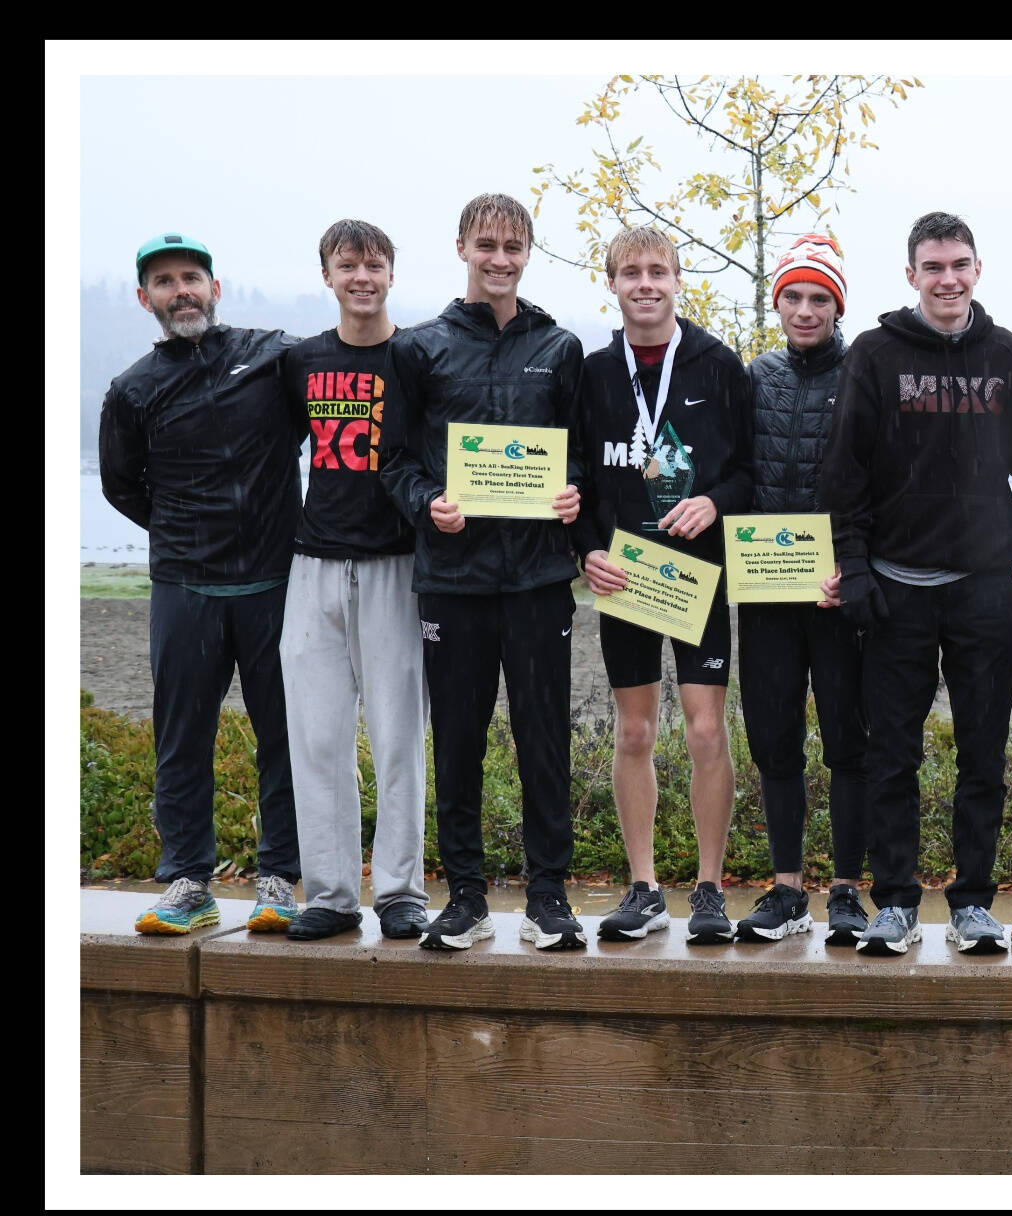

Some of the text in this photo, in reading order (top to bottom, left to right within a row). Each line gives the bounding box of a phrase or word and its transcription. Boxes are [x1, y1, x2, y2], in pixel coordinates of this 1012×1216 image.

[307, 371, 373, 400] NIKE
[308, 403, 369, 416] PORTLAND
[310, 419, 370, 472] XC
[505, 481, 545, 489] Individual
[634, 589, 652, 600] Place
[653, 595, 689, 613] Individual
